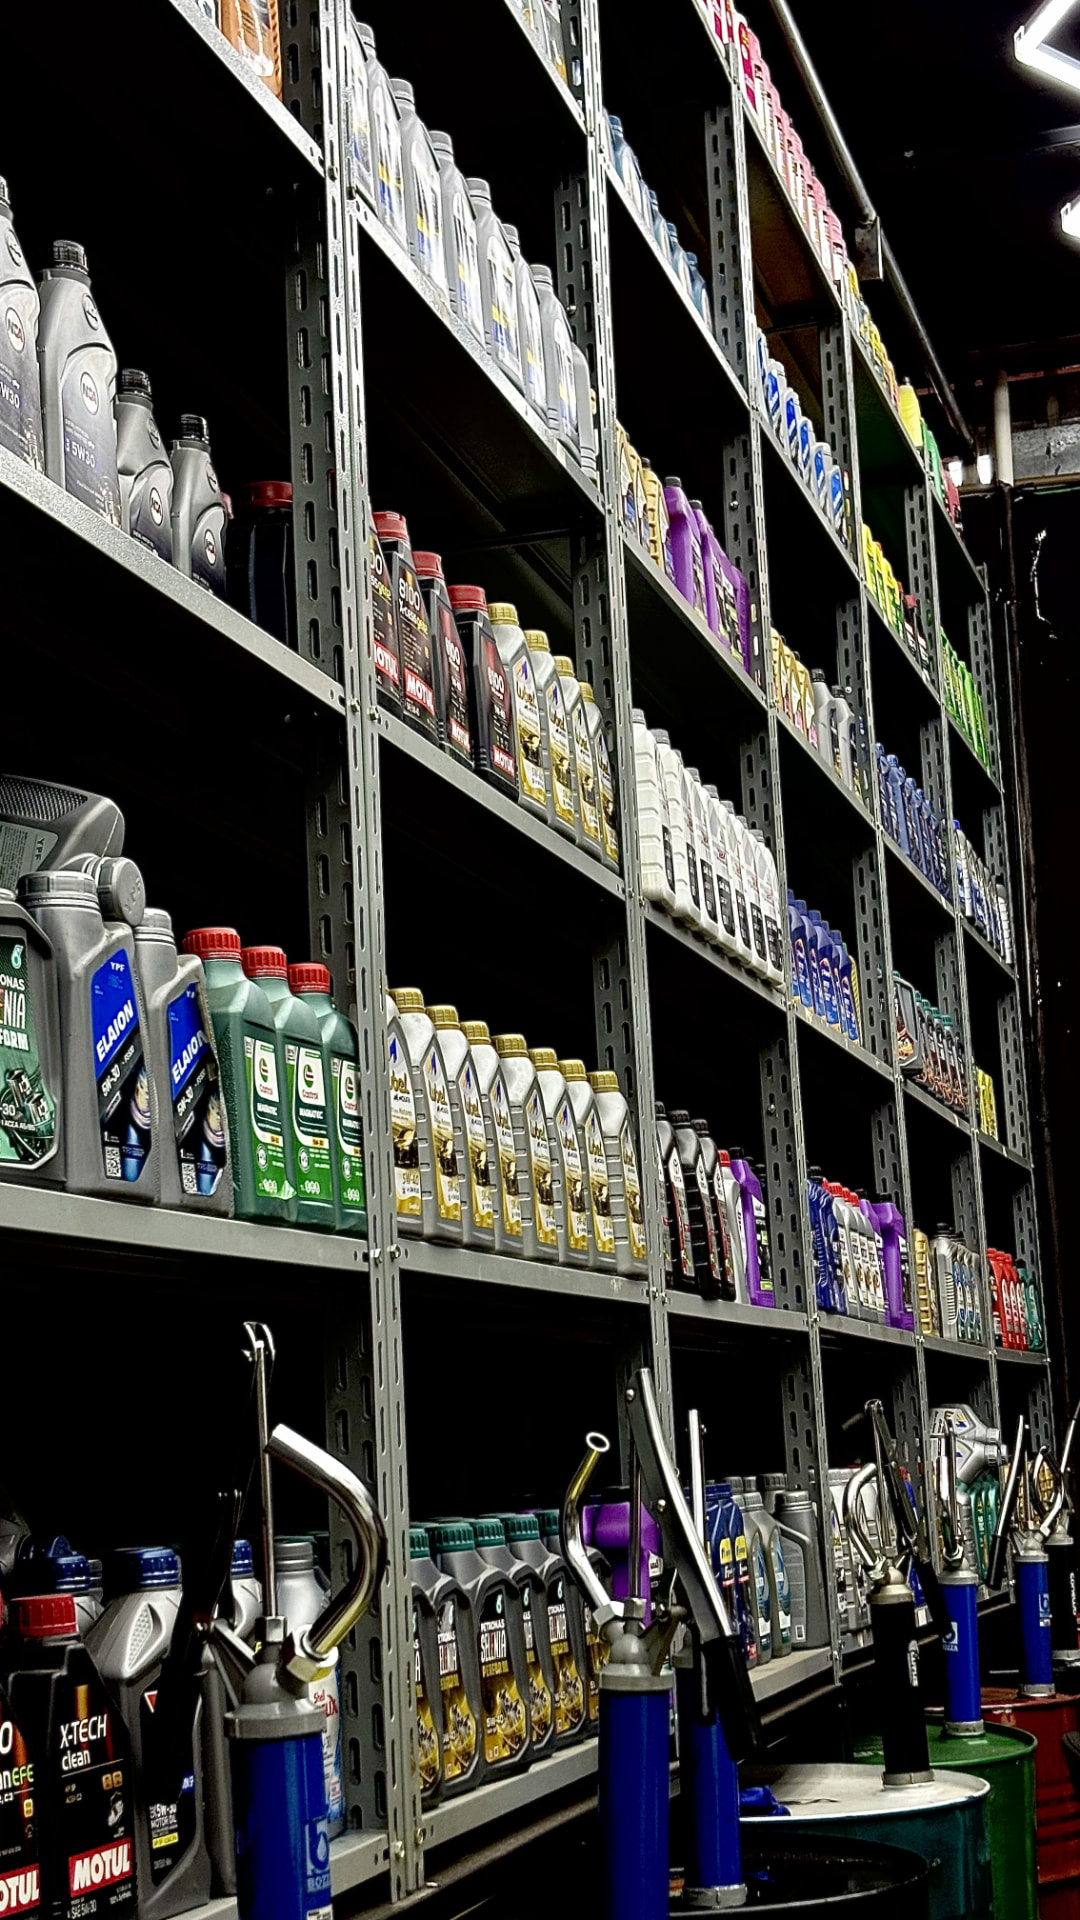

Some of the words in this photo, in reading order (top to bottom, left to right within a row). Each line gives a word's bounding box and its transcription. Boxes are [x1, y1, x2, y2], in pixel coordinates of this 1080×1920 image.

[71, 440, 97, 469] 5W30
[407, 673, 434, 713] MOTUL
[110, 961, 125, 972] YPF
[96, 999, 134, 1062] ELAION
[60, 1713, 108, 1750] X-TECH
[62, 1749, 91, 1771] clean
[73, 1842, 131, 1892] MOTUL
